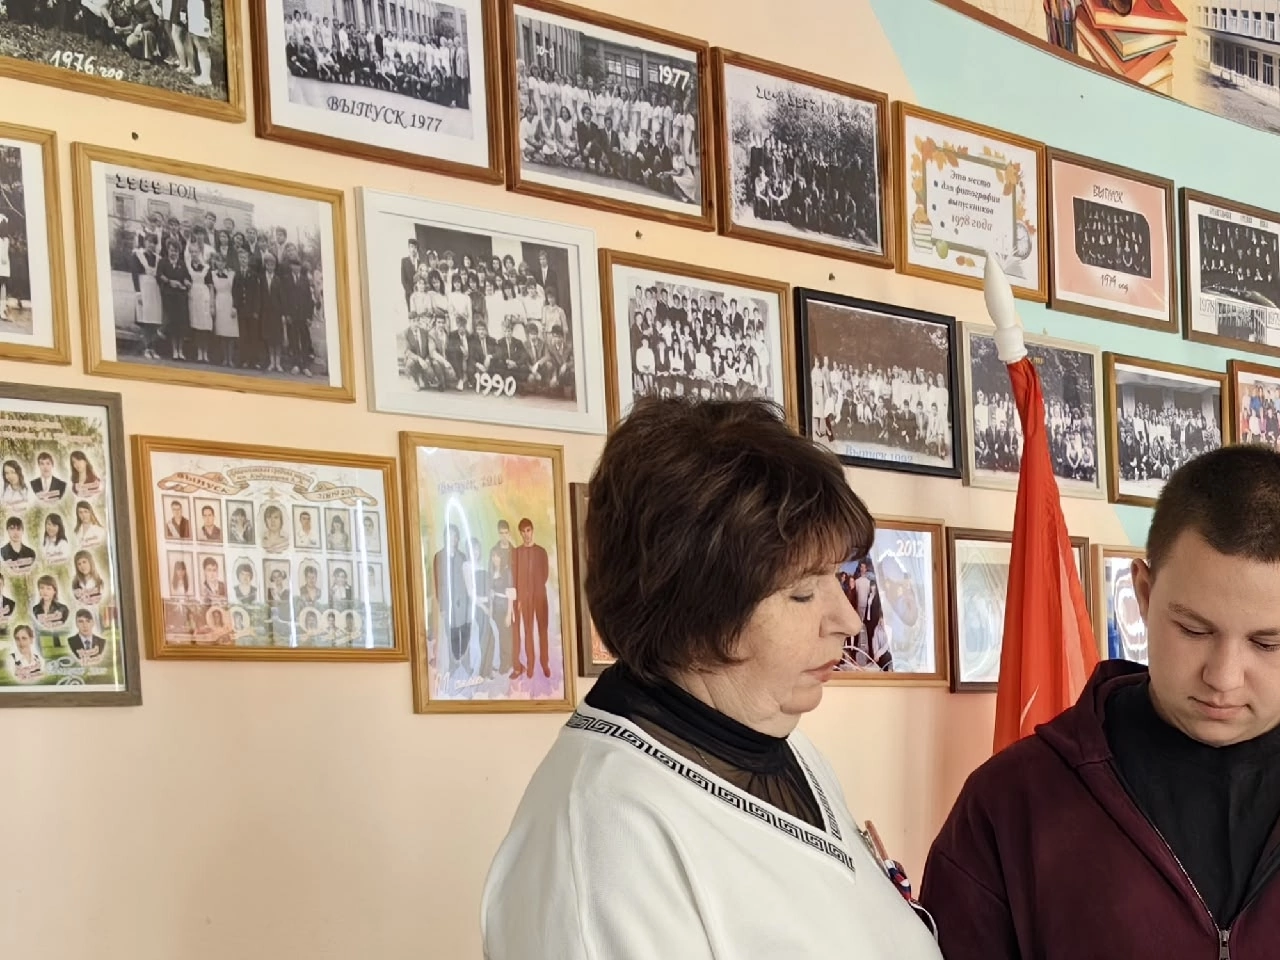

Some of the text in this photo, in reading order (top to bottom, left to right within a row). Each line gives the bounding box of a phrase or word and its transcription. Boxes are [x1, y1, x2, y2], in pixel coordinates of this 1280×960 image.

[50, 50, 97, 75] 1976
[658, 64, 690, 91] 1977
[327, 96, 443, 132] ВЫПУСК 1977
[940, 180, 1001, 204] для фотографии
[967, 176, 991, 189] место
[948, 197, 994, 215] выпускников
[971, 217, 993, 232] года
[474, 372, 517, 397] 1990
